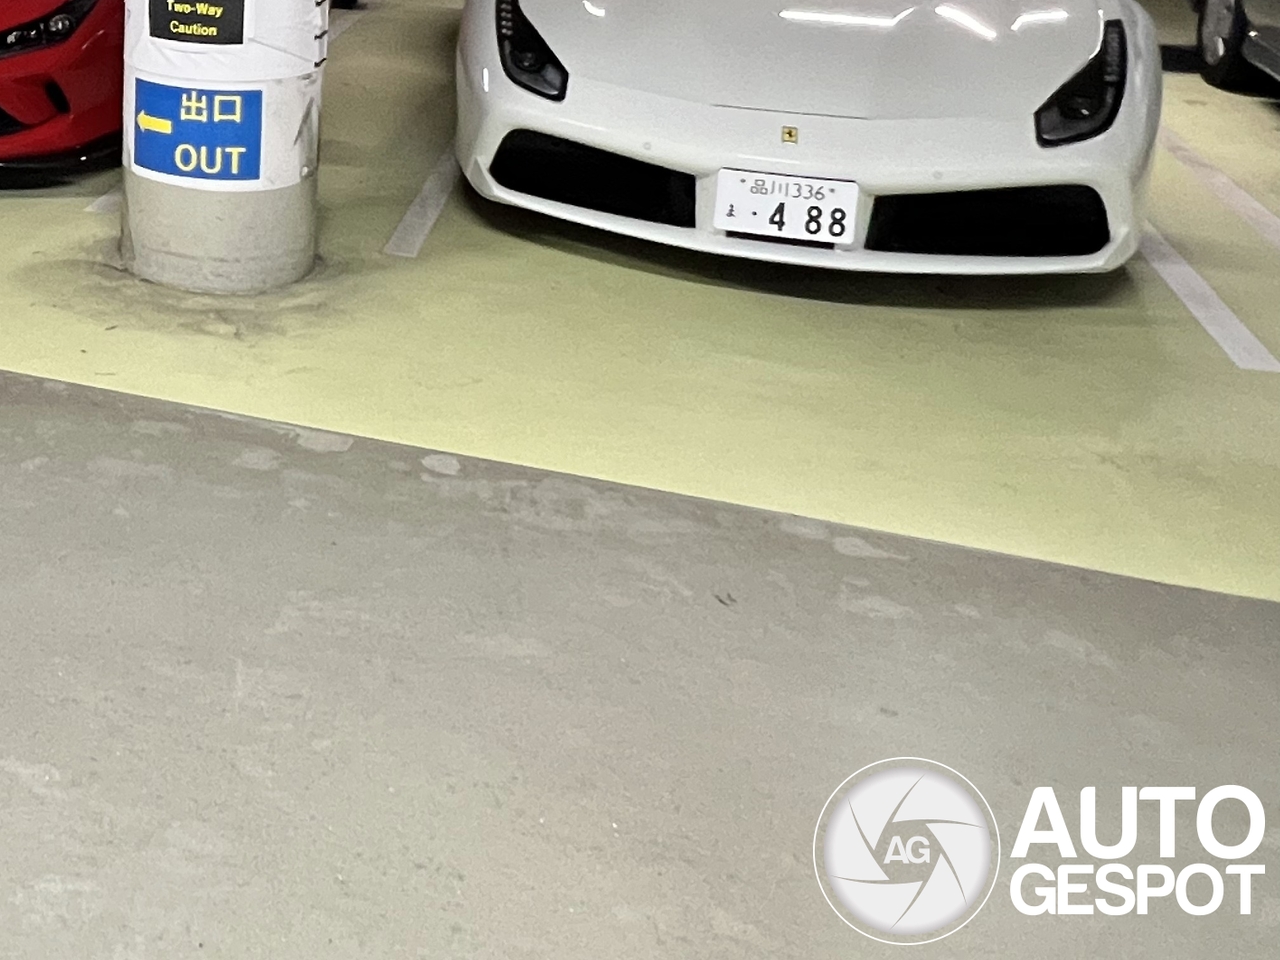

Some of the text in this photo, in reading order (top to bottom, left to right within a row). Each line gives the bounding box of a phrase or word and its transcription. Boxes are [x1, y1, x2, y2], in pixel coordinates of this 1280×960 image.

[166, 0, 223, 18] Two-Way
[169, 20, 217, 36] Caution
[180, 91, 242, 123] 出口
[174, 144, 246, 174] OUT
